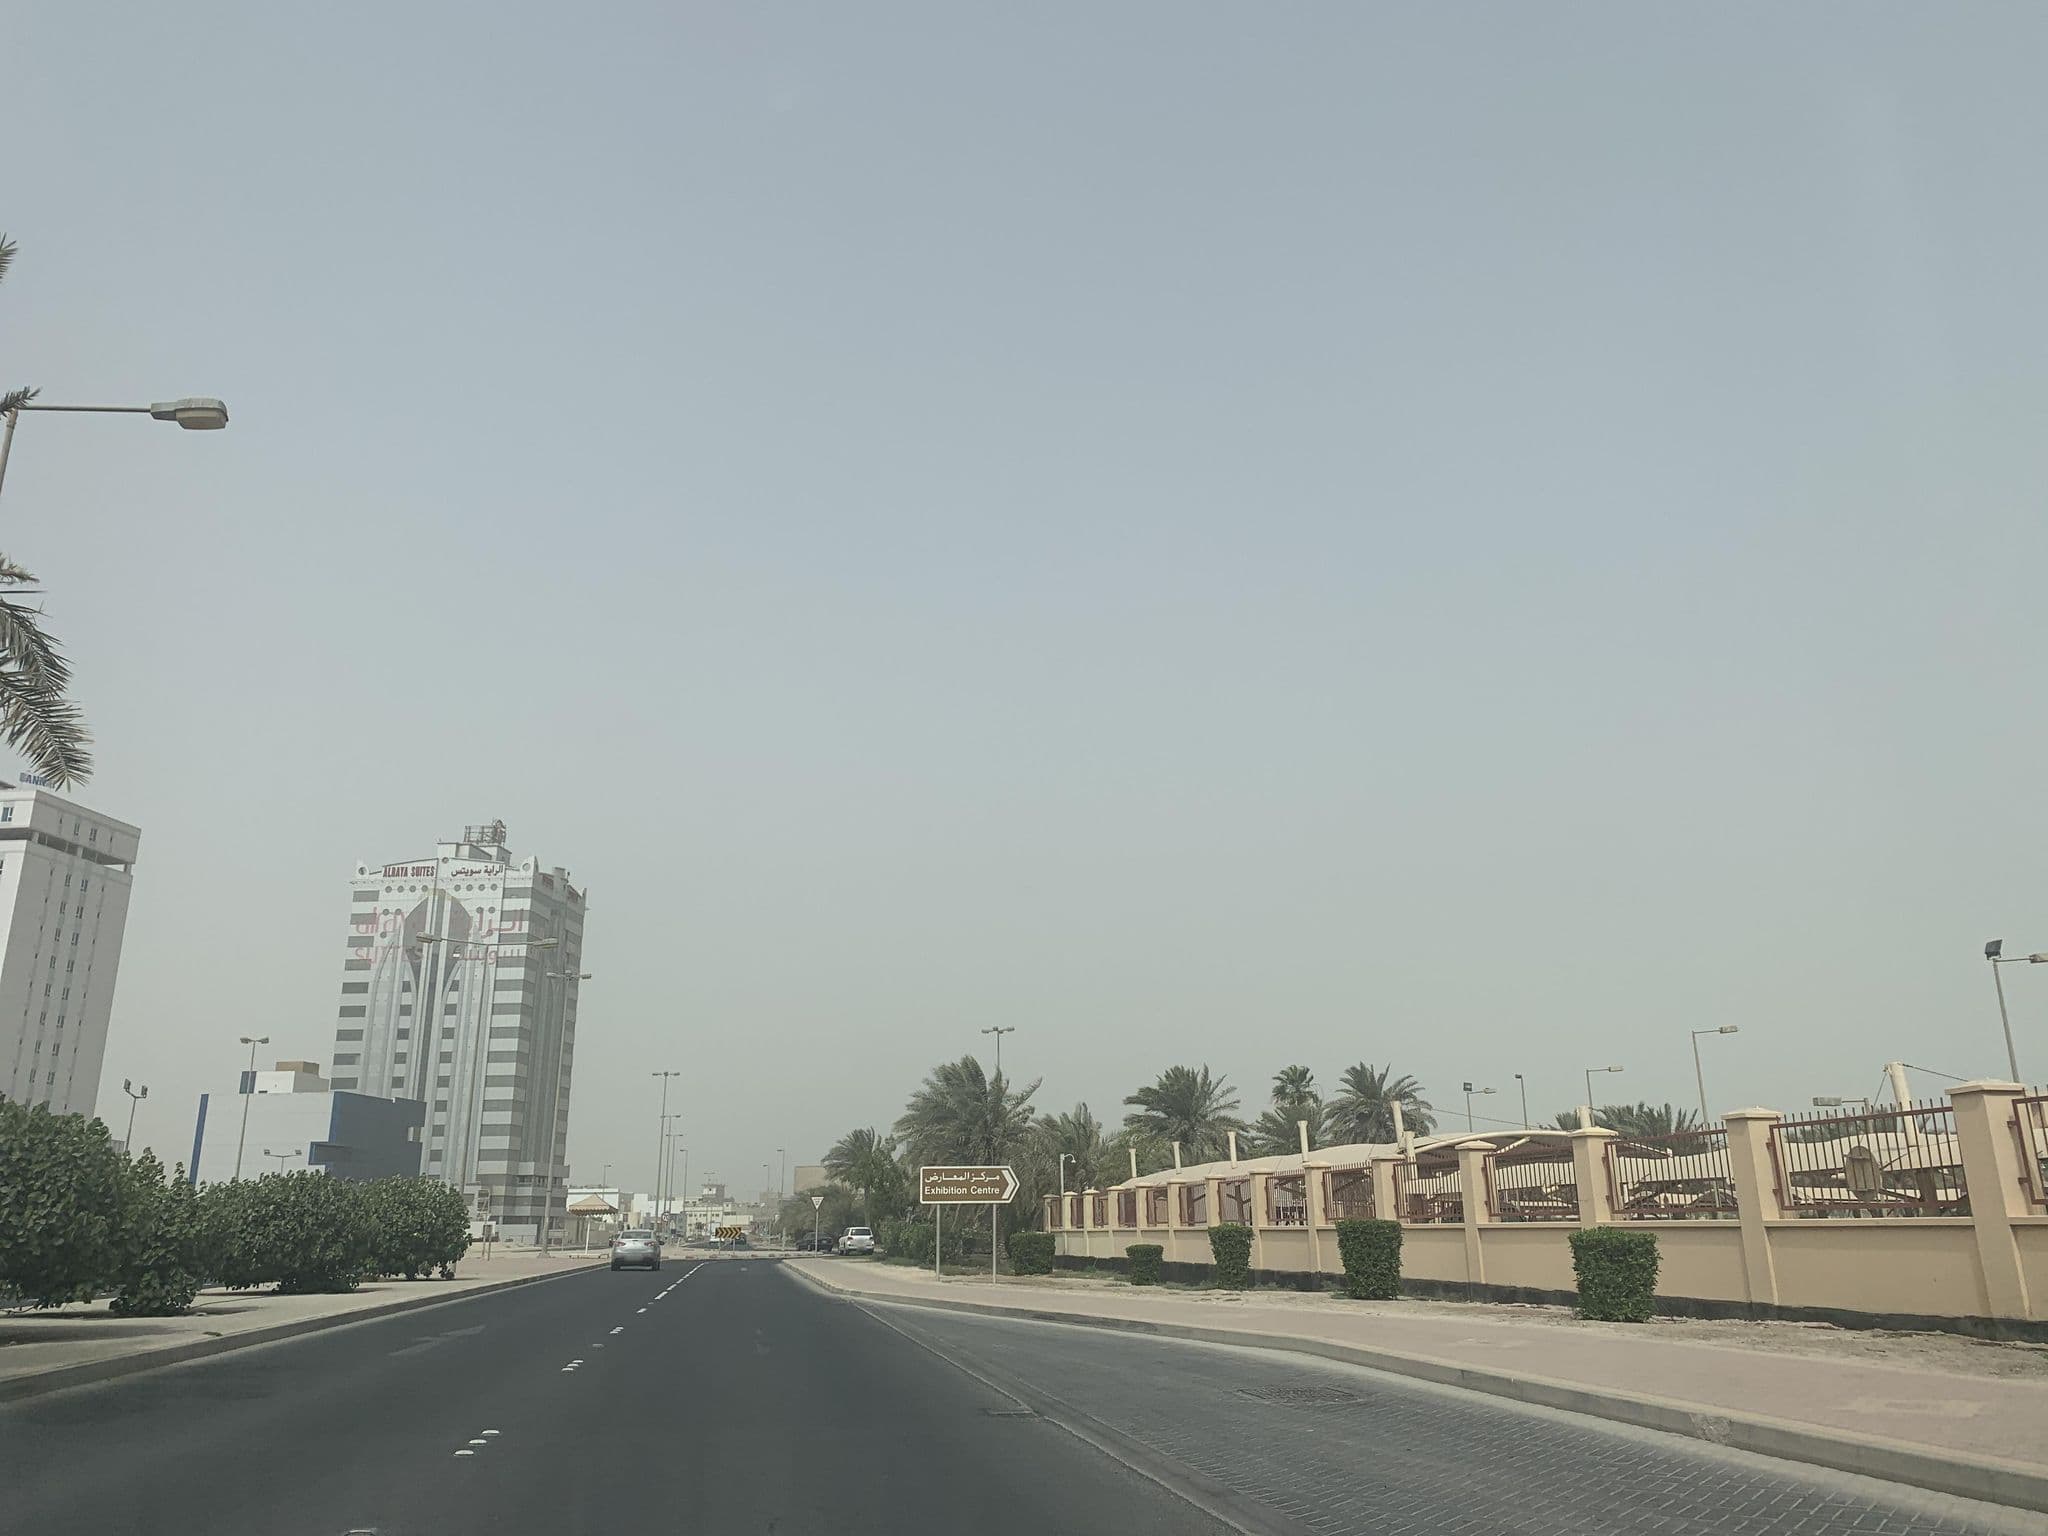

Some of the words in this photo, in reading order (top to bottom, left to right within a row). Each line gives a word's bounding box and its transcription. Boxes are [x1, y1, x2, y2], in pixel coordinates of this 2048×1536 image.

[383, 865, 408, 878] ALRAYA
[410, 866, 435, 877] SUITES
[924, 1171, 970, 1183] المعارض
[972, 1171, 1000, 1182] مركز
[924, 1186, 968, 1195] Exhibition
[970, 1185, 1000, 1195] Centre
